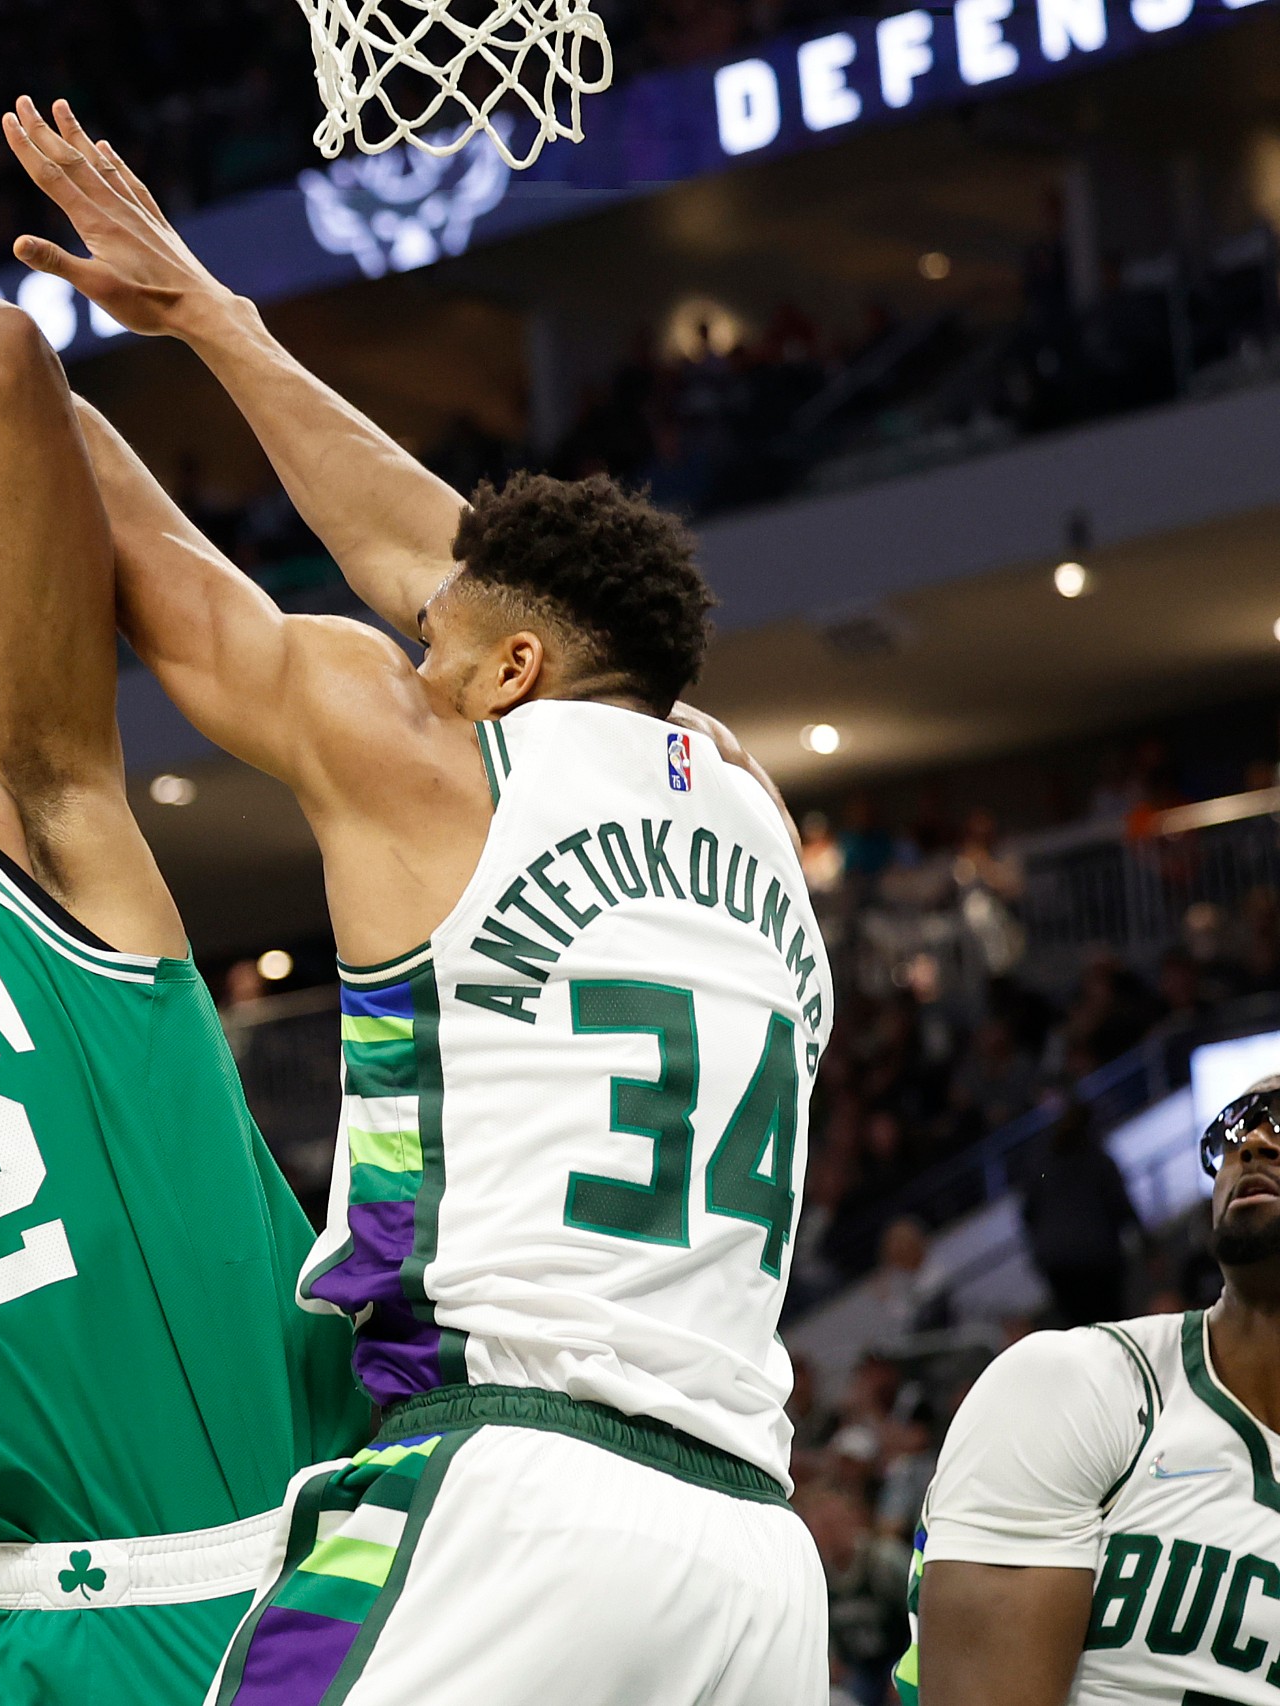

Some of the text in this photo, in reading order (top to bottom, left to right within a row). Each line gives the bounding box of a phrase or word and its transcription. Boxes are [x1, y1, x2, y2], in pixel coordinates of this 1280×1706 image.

[714, 0, 1268, 156] DEFEN
[563, 979, 799, 1281] 34
[1083, 1533, 1280, 1690] BUC
